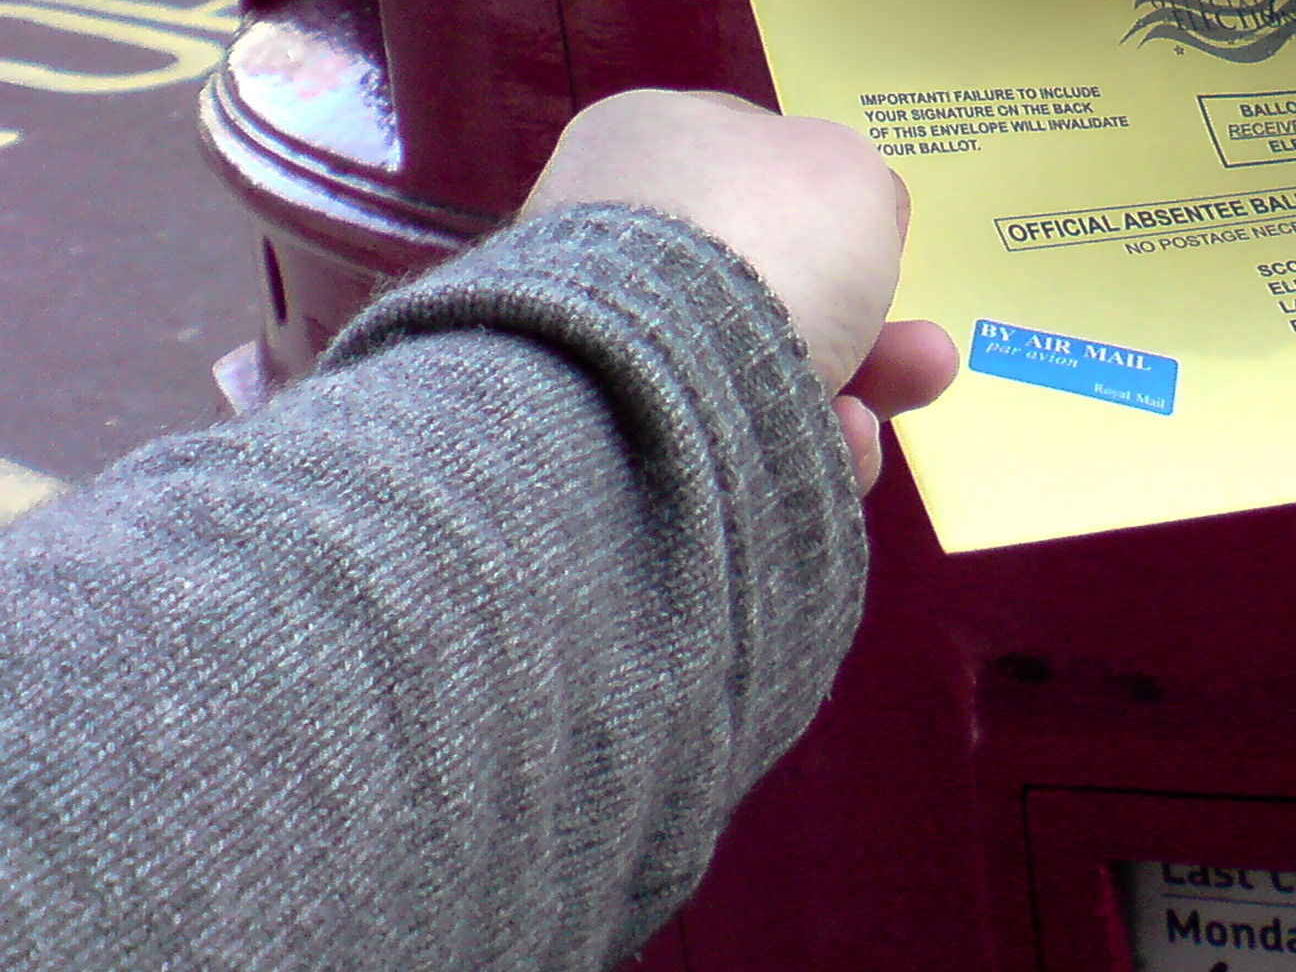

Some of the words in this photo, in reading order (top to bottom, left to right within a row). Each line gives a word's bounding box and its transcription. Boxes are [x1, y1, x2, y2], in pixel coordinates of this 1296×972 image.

[860, 92, 950, 106] IMPORTANT!
[954, 88, 1014, 102] FAILURE
[1017, 87, 1036, 100] TO
[1040, 85, 1101, 99] INCLUDE
[865, 108, 907, 122] YOUR
[911, 104, 994, 119] SIGNATURE
[999, 103, 1020, 116] ON
[1023, 102, 1049, 115] THE
[1055, 101, 1094, 114] BACK
[869, 127, 888, 139] OF
[893, 125, 927, 138] THIS
[931, 122, 1007, 136] ENVELOPE
[1012, 119, 1046, 132] WILL
[1049, 115, 1129, 130] INVALIDATE
[919, 139, 981, 154] BALLOT.
[1008, 214, 1120, 242] OFFICIAL
[1124, 200, 1248, 229] ABSENTEE
[1125, 241, 1157, 255] NO
[1163, 229, 1250, 251] POSTAGE
[981, 323, 1015, 342] BY
[1025, 334, 1072, 354] AIR
[1083, 344, 1152, 371] MAIL
[986, 341, 1022, 353] par
[1026, 350, 1079, 369] avion
[1094, 382, 1131, 401] Royal
[1137, 393, 1166, 409] Mail
